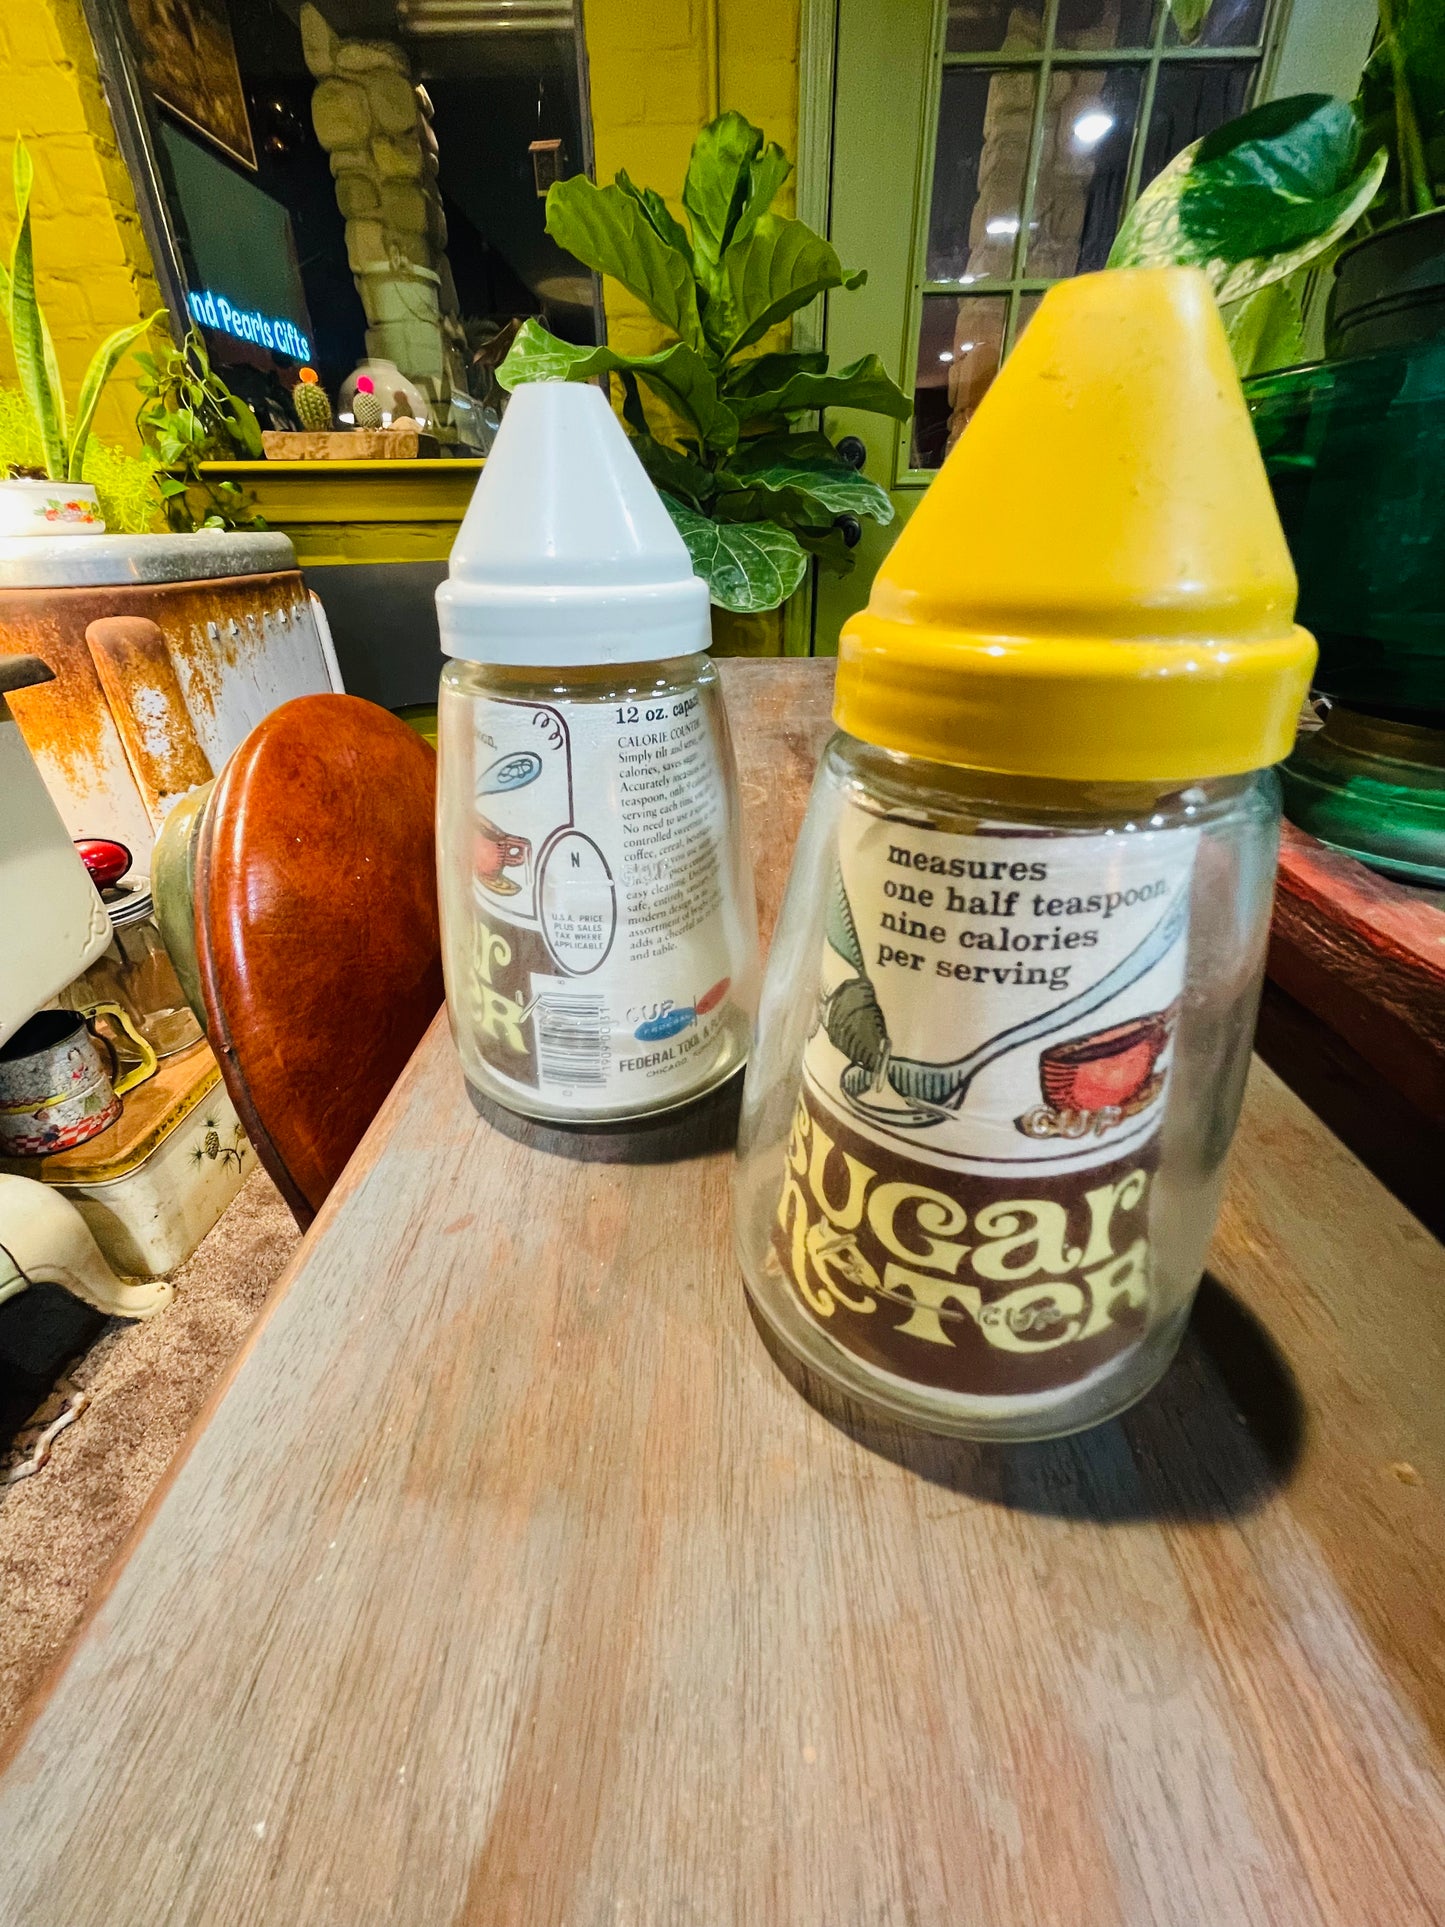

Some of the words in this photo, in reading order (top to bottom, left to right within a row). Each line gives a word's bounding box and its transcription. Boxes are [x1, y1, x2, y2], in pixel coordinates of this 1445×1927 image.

[190, 290, 220, 328] nd
[217, 298, 274, 348] Pearls
[616, 707, 639, 724] 12
[646, 708, 668, 721] oz.
[618, 731, 668, 748] CALORIE
[619, 748, 652, 764] Simply
[655, 746, 668, 758] tilt
[619, 764, 660, 778] calories,
[620, 775, 670, 792] Accurately
[621, 793, 667, 807] teaspoon,
[622, 807, 657, 821] serving
[660, 800, 678, 815] each
[623, 823, 640, 834] No
[643, 818, 663, 831] need
[666, 818, 674, 827] to
[624, 829, 671, 848] controlled
[571, 852, 580, 868] N
[624, 849, 657, 862] coffee,
[886, 844, 1048, 882] measures
[626, 889, 647, 901] easy
[883, 879, 934, 908] one
[945, 886, 1019, 917] half
[627, 900, 651, 912] safe,
[628, 910, 666, 925] modern
[554, 923, 574, 931] PLUS
[578, 924, 602, 932] SALES
[628, 917, 680, 937] assortment
[880, 911, 946, 943] nine
[959, 926, 1099, 952] calories
[554, 941, 603, 950] APPLICABLE
[575, 933, 602, 941] WHERE
[630, 938, 653, 950] adds
[630, 949, 650, 961] and
[653, 942, 677, 956] table.
[877, 942, 925, 972] per
[936, 961, 1072, 991] serving
[620, 1048, 676, 1072] FEDERAL
